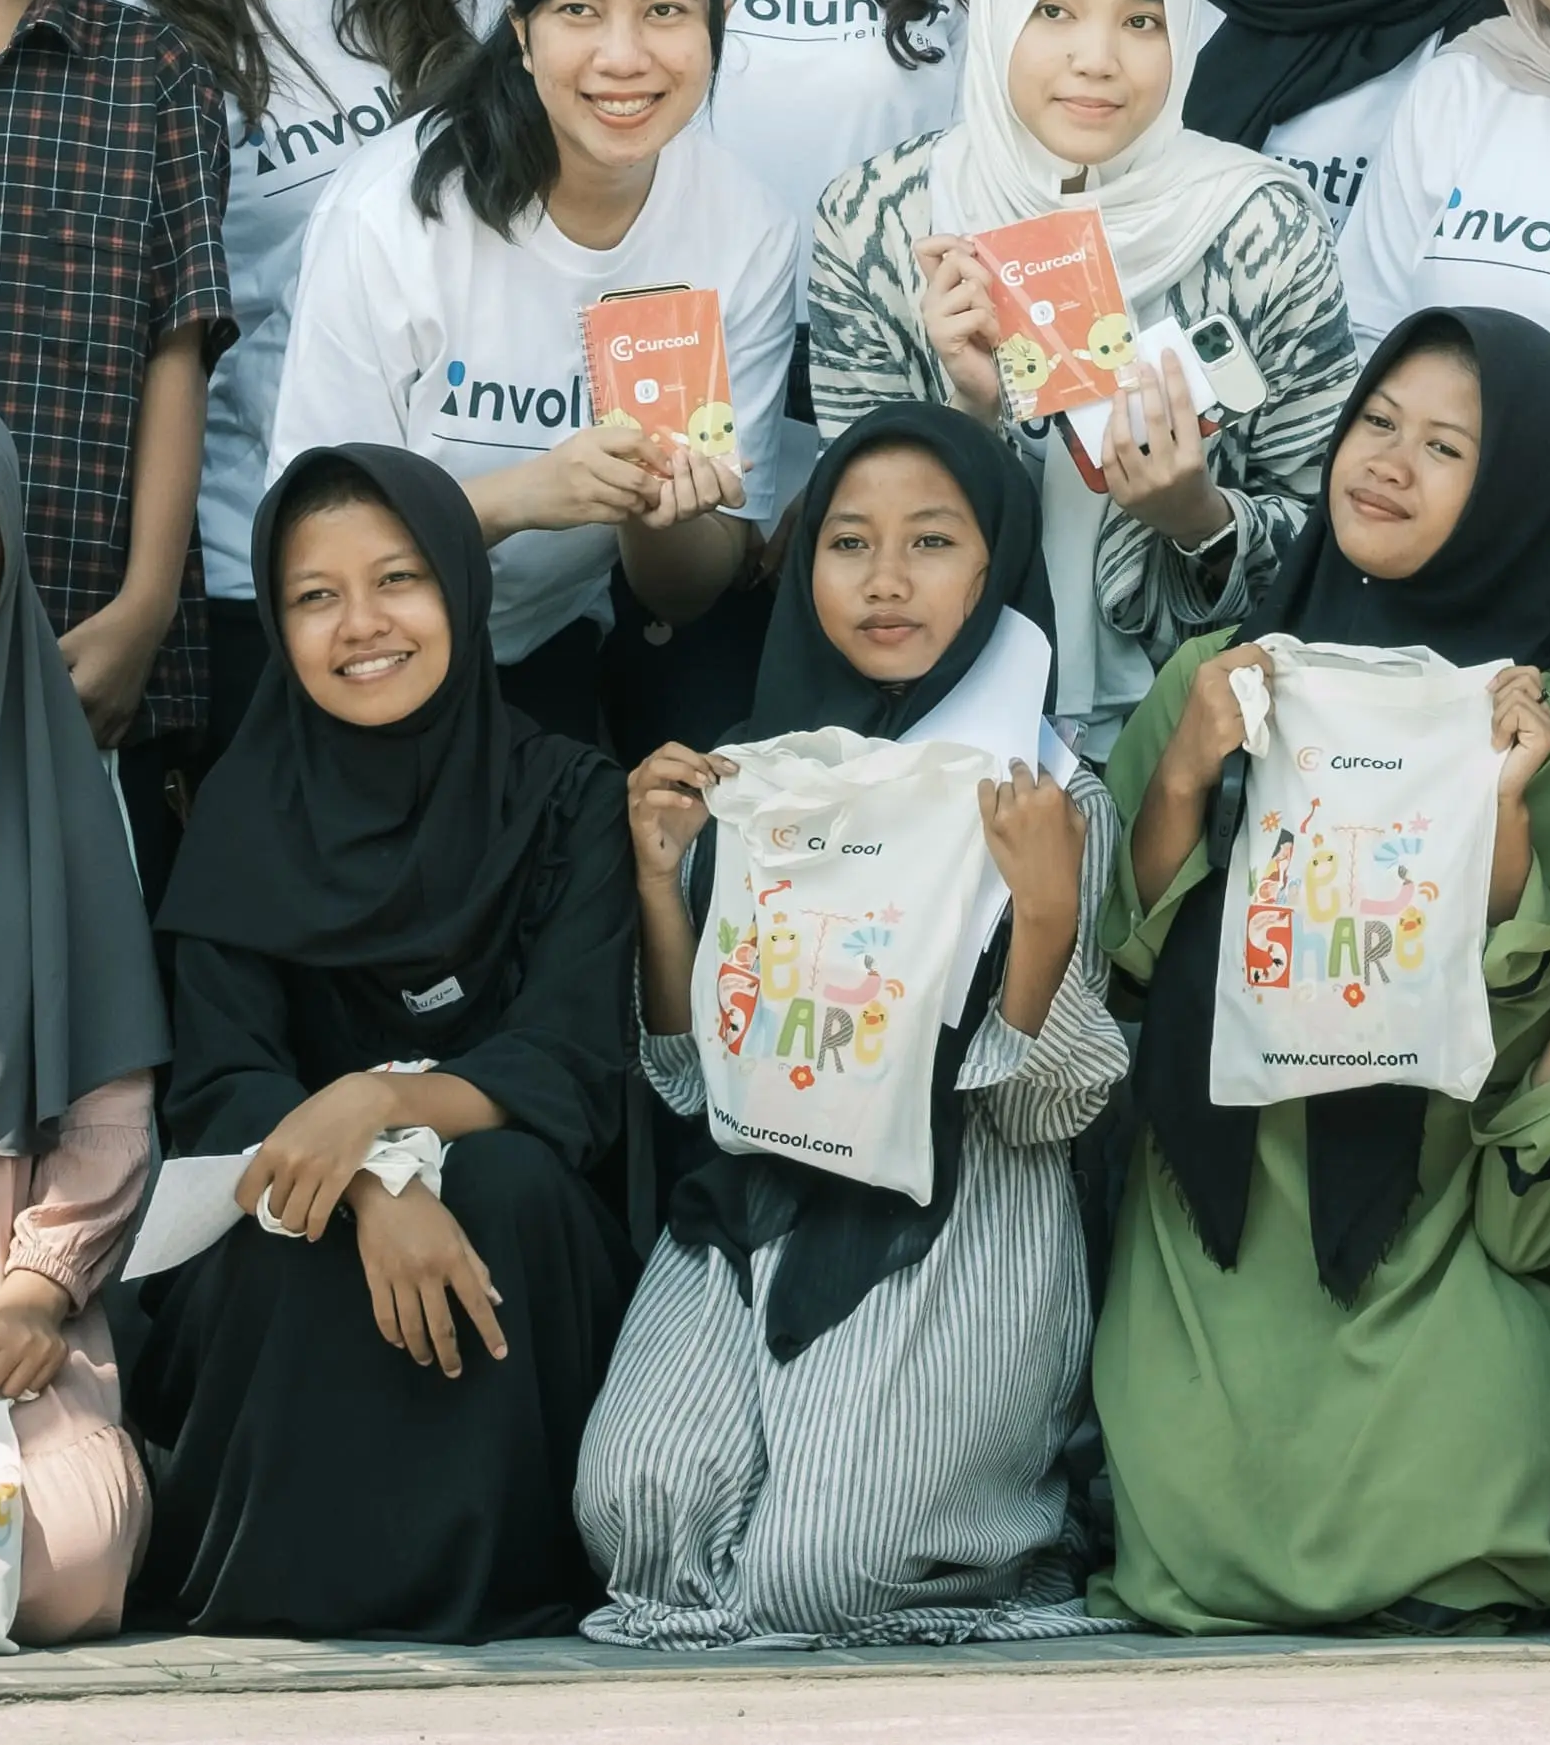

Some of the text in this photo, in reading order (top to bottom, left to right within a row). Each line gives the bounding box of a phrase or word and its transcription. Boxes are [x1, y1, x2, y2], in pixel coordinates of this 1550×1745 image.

[1024, 247, 1087, 276] Curcool
[635, 331, 699, 353] Curcool
[440, 361, 581, 429] invol
[1331, 756, 1403, 771] Curcool
[1262, 1052, 1418, 1067] www.curcool.com
[714, 1107, 853, 1158] www.curcool.com
